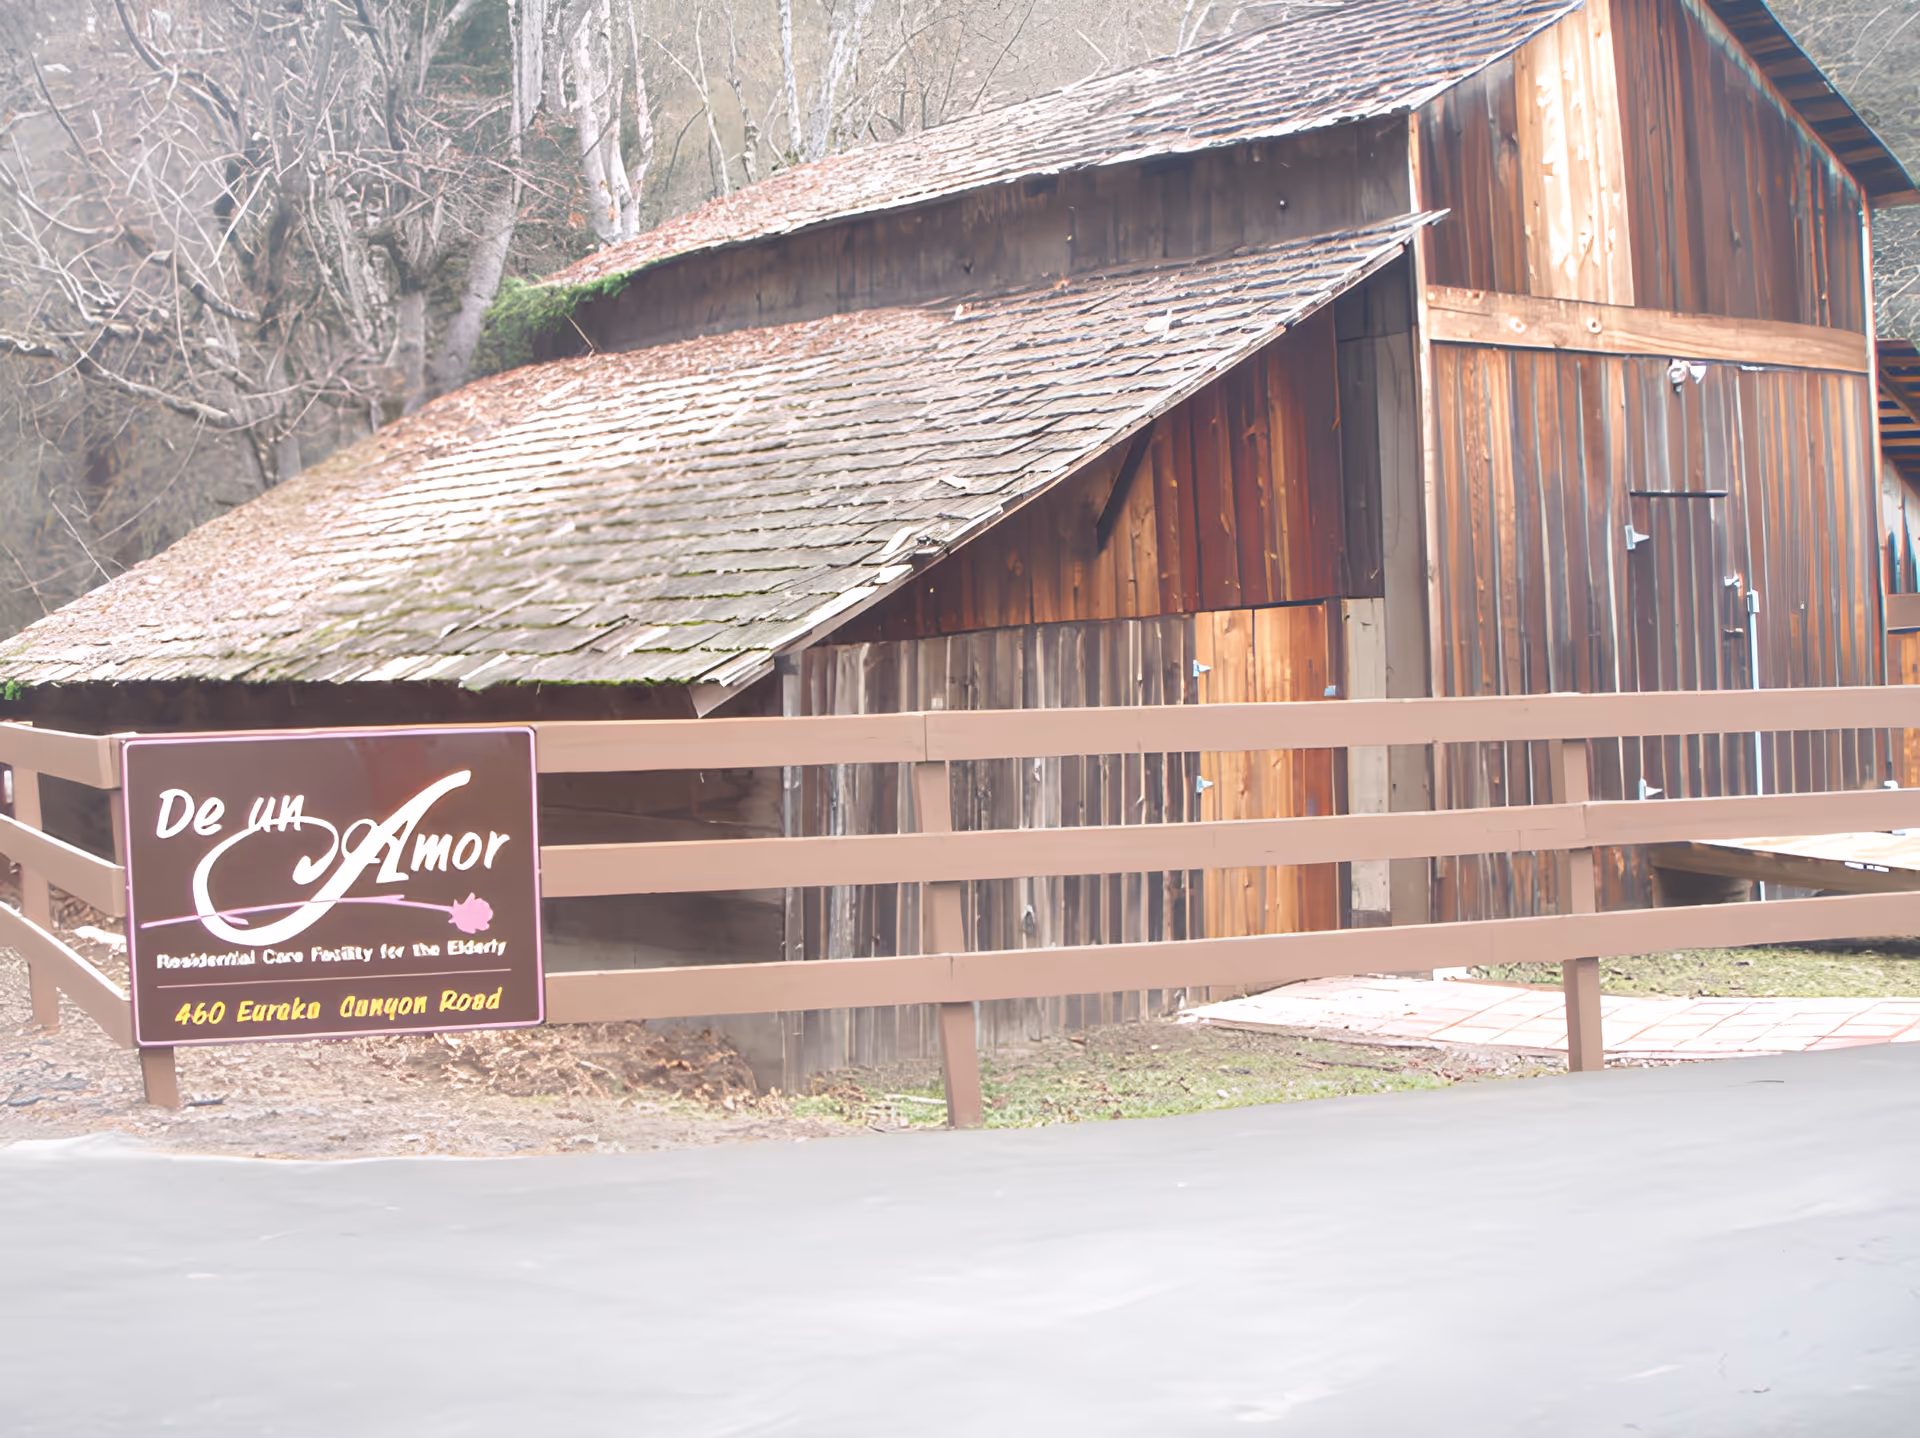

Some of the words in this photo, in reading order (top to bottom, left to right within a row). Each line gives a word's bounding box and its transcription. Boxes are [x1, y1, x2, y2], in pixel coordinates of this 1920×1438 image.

[156, 788, 225, 838] De
[248, 795, 305, 832] un
[156, 950, 256, 969] Residential
[262, 948, 304, 964] Care
[311, 946, 374, 962] Facility
[380, 943, 406, 959] for
[412, 942, 441, 957] the
[447, 939, 507, 956] Elderly
[174, 1001, 226, 1025] 460
[339, 995, 428, 1020] Canyon
[438, 986, 503, 1012] Road
